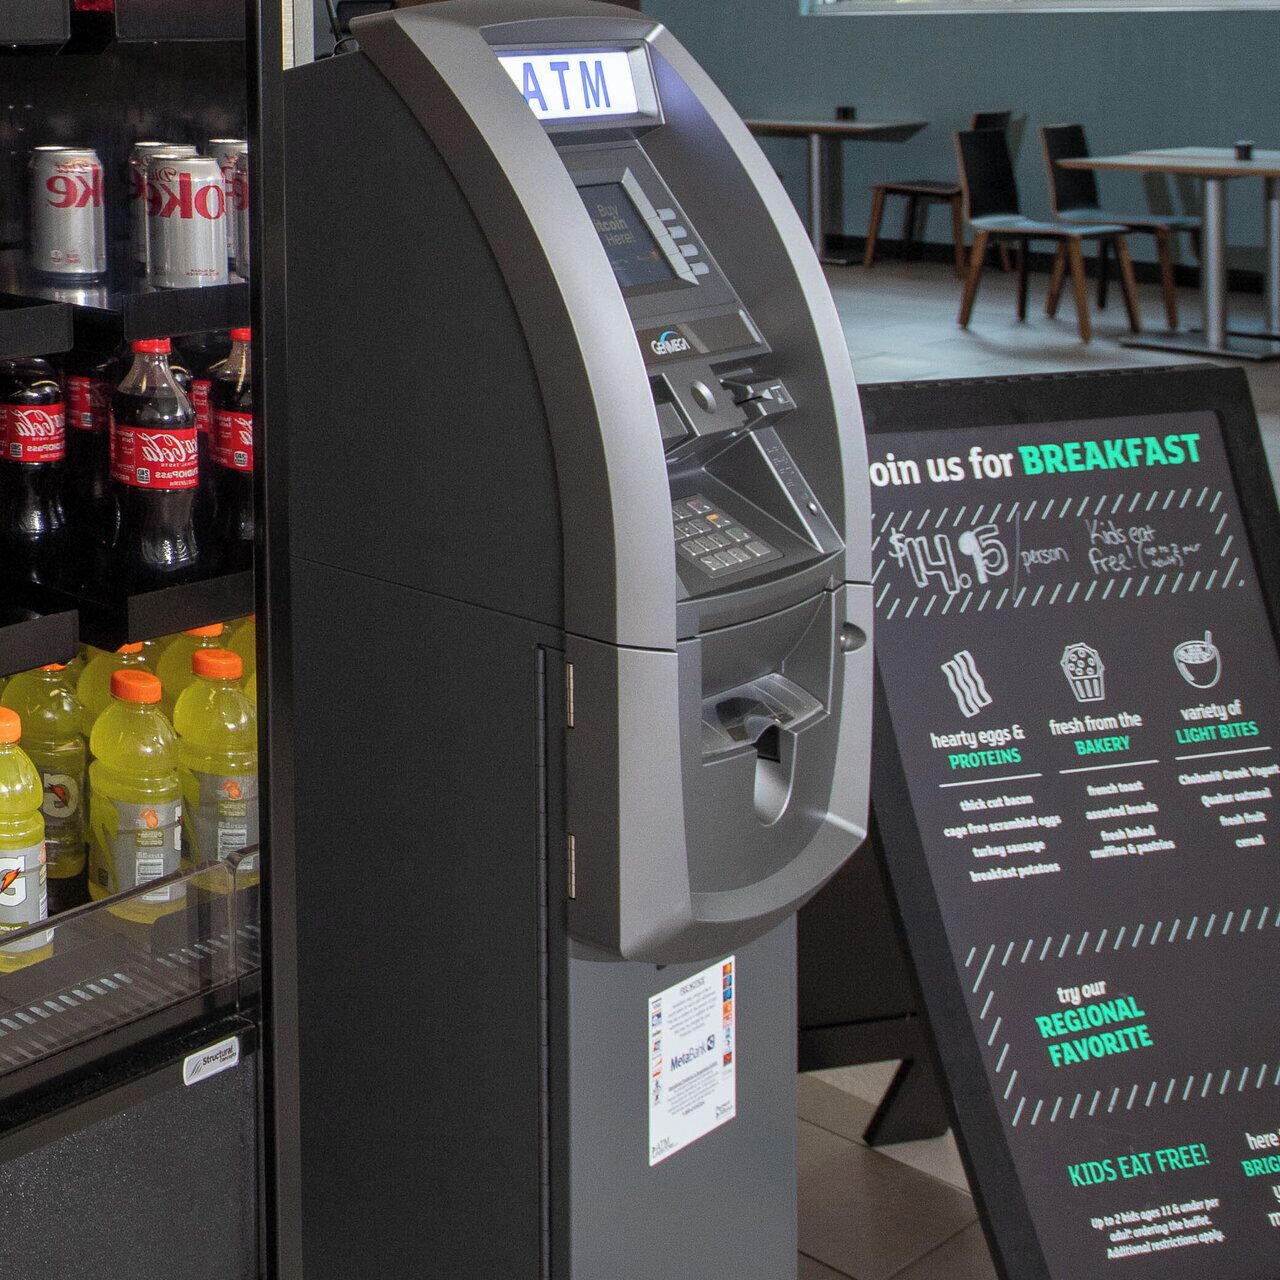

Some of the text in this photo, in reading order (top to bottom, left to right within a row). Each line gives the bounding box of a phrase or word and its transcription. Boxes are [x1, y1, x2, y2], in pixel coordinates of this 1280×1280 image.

[523, 61, 611, 111] ATM
[869, 433, 1200, 487] oin us for BREAKFAST
[1085, 519, 1156, 545] Kids eat
[1022, 546, 1069, 573] person
[1180, 699, 1243, 722] variety of
[930, 724, 1026, 750] hearty eggs &
[1049, 712, 1144, 736] fresh from the
[1175, 720, 1260, 745] LIGHT BITES
[948, 747, 1022, 770] PROTEINS
[1074, 735, 1131, 756] BAKERY
[1056, 980, 1106, 1006] try our
[1034, 996, 1146, 1039] REGIONAL
[202, 1045, 234, 1066] Structural
[670, 1044, 707, 1071] MetaBank
[1048, 1023, 1154, 1068] FAVORITE
[1068, 1143, 1211, 1186] KIDS EAT FREE!
[1241, 1154, 1280, 1177] BRIG
